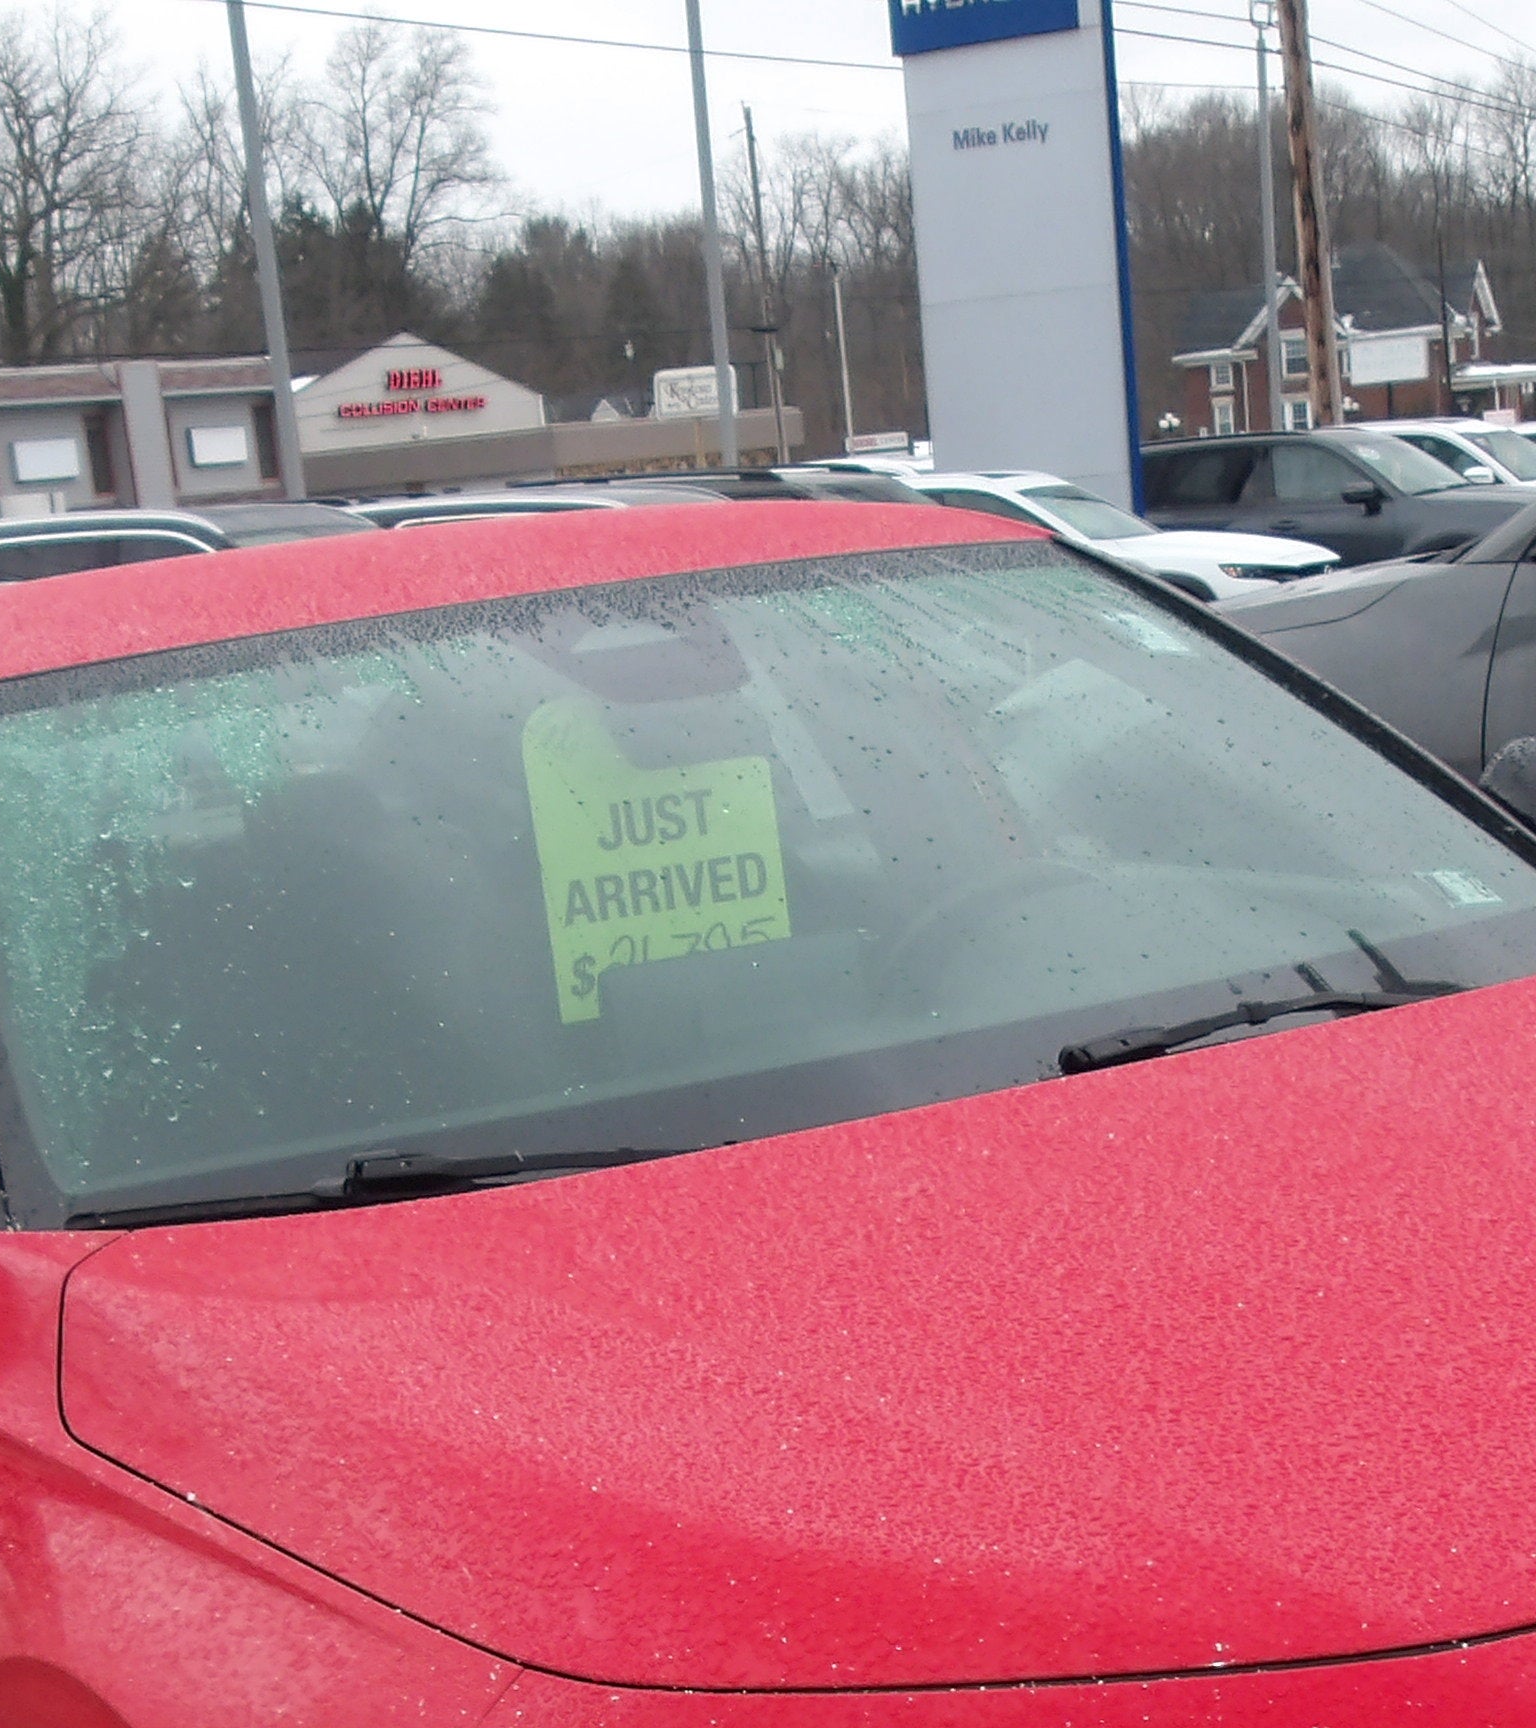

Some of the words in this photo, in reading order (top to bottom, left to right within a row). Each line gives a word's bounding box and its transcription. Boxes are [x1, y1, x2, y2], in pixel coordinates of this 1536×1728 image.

[952, 126, 997, 151] Mike
[1002, 118, 1050, 145] Kelly
[338, 398, 421, 418] COLLISION
[425, 394, 490, 413] CENTER
[596, 788, 713, 852] JUST
[562, 850, 768, 928] ARRIVED
